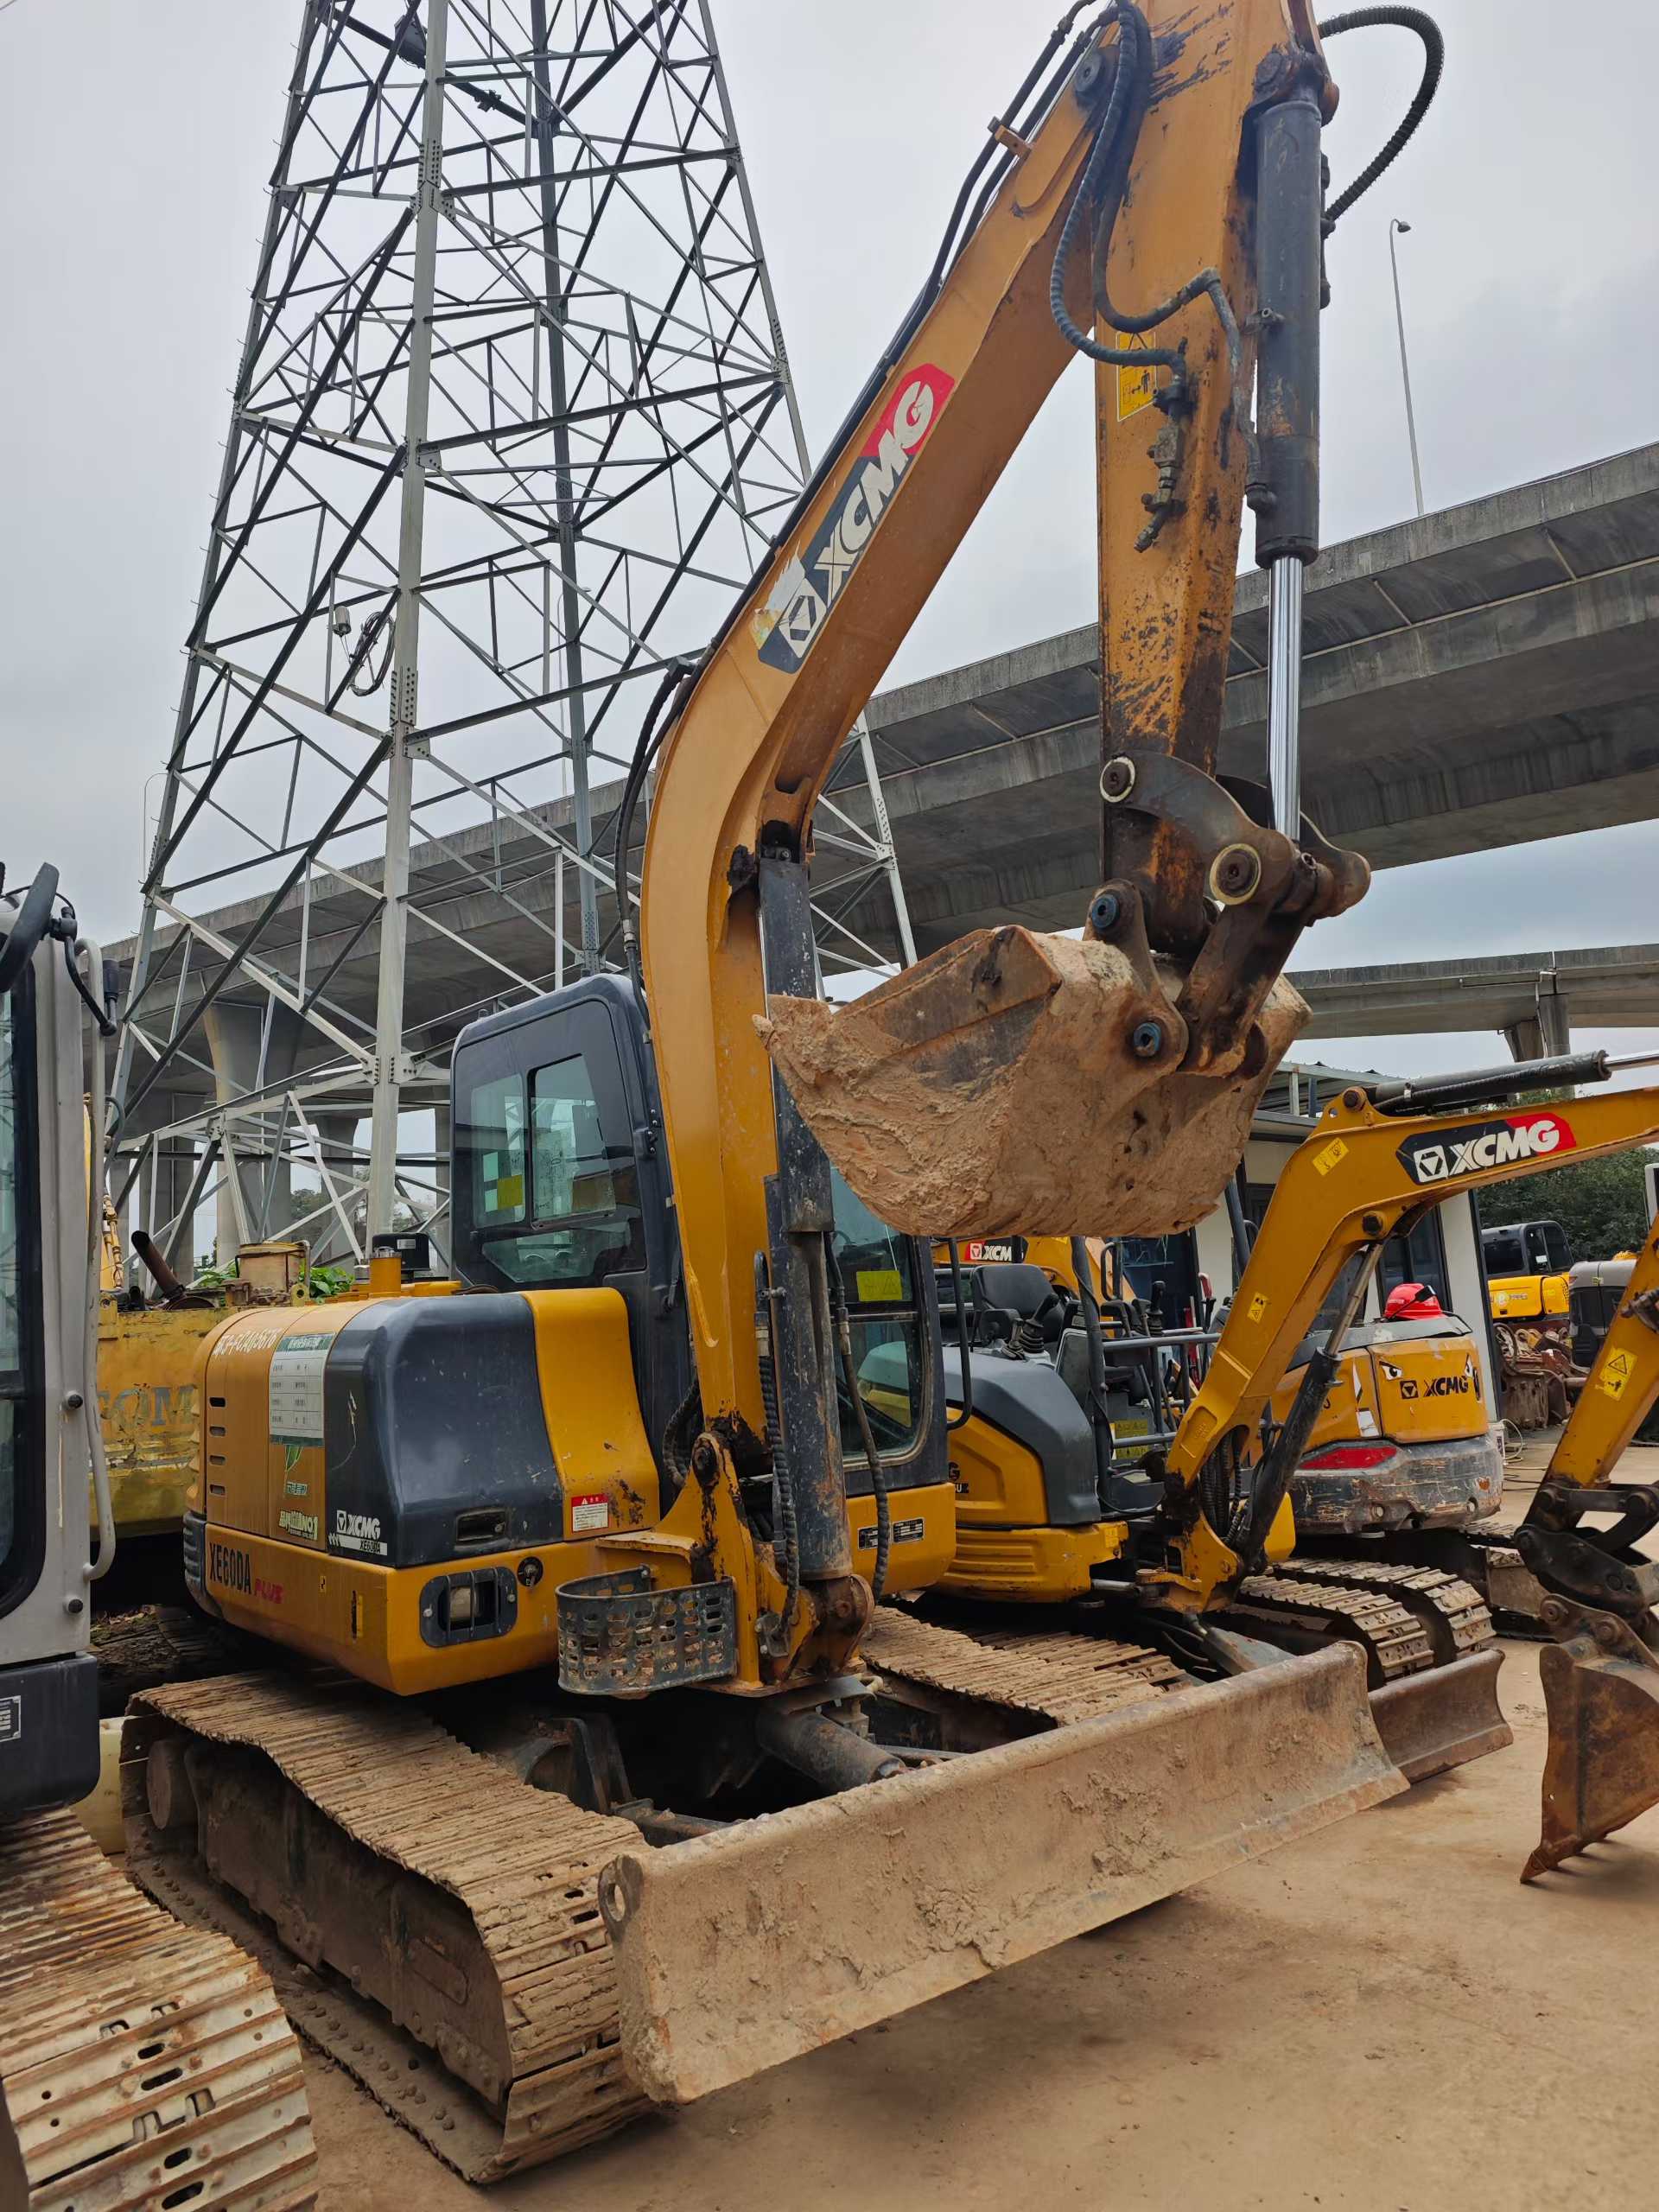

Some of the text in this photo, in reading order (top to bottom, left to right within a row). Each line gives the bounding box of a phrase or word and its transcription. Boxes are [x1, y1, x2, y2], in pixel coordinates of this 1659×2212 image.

[814, 380, 934, 608] XCMG
[1448, 1120, 1560, 1176] XCMG
[983, 1245, 1024, 1262] XCM
[1423, 1376, 1469, 1397] XCMG
[346, 1514, 381, 1540] XCMG
[210, 1542, 251, 1594] XE60DA
